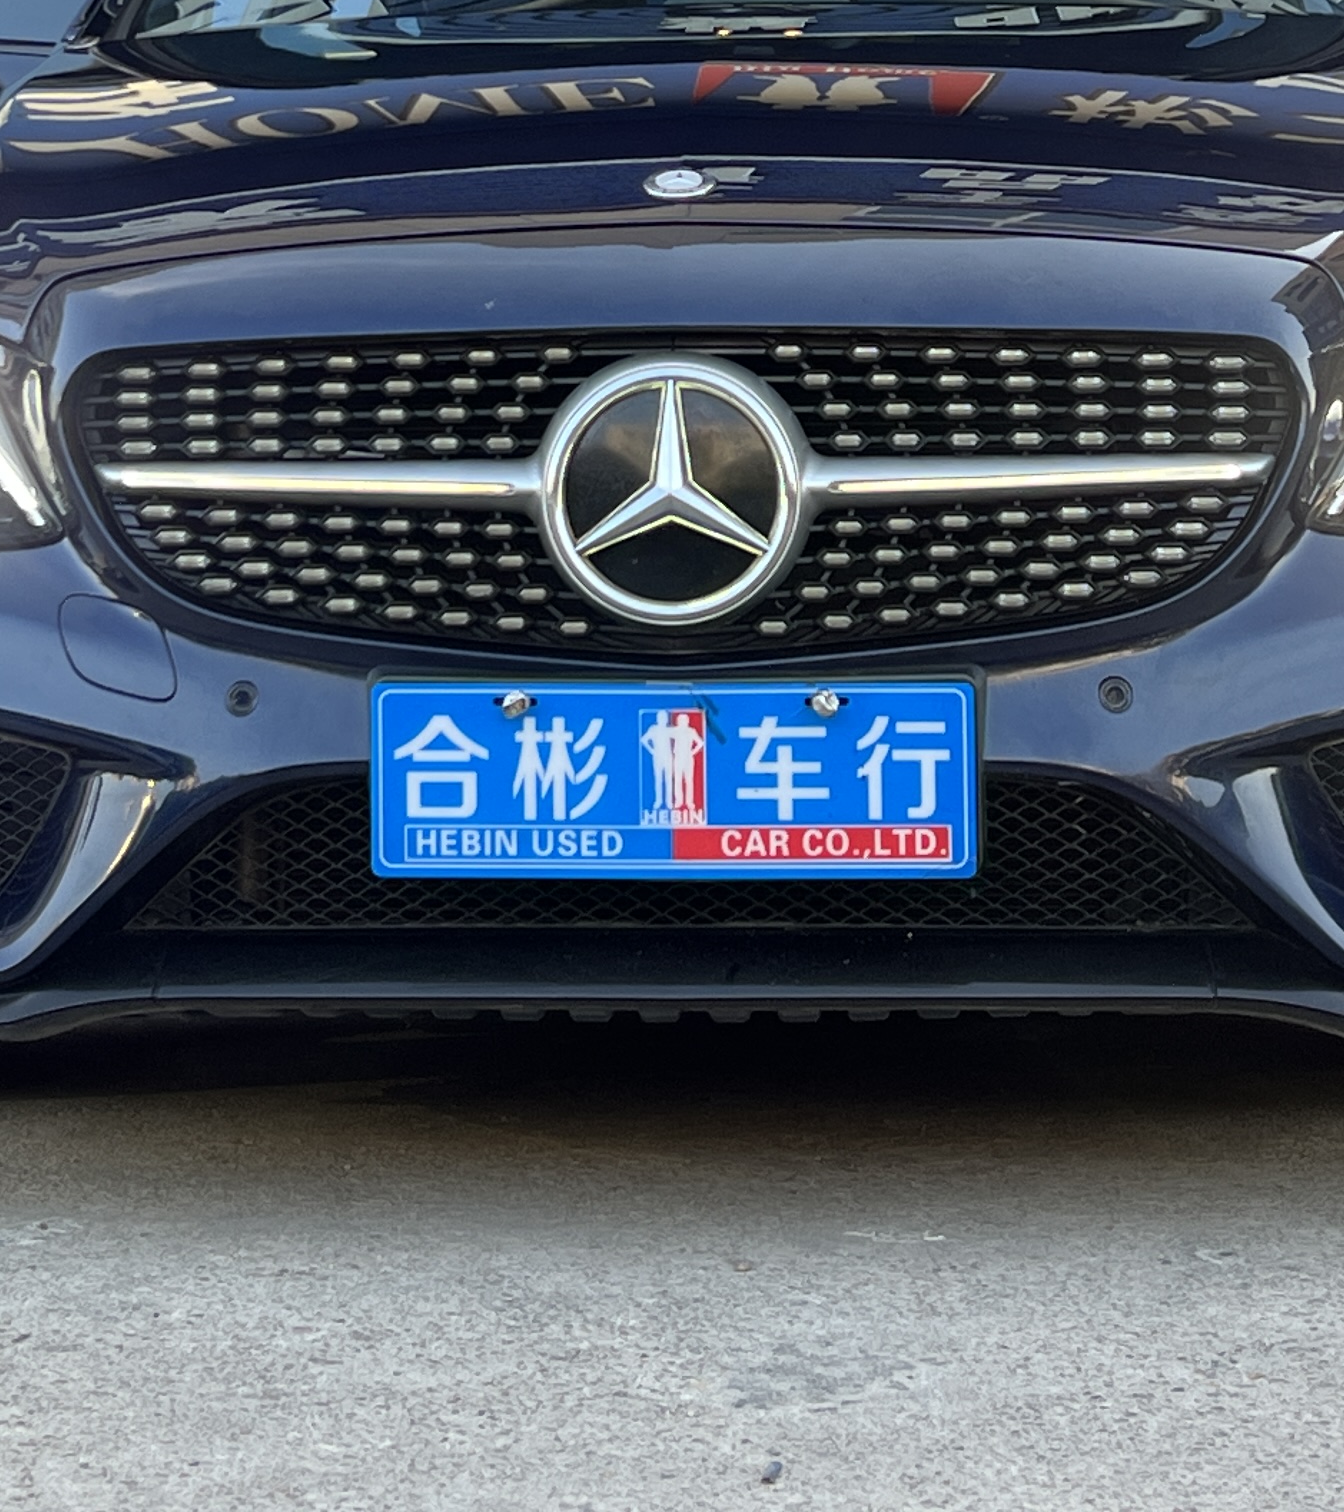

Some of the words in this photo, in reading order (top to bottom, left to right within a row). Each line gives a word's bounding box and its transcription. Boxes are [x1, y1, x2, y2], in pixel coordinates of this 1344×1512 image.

[393, 714, 610, 822] 合彬
[735, 715, 952, 822] 车行
[643, 809, 705, 826] HEBIN
[414, 829, 519, 858] HEBIN
[532, 828, 624, 858] USED
[720, 828, 790, 857] CAR
